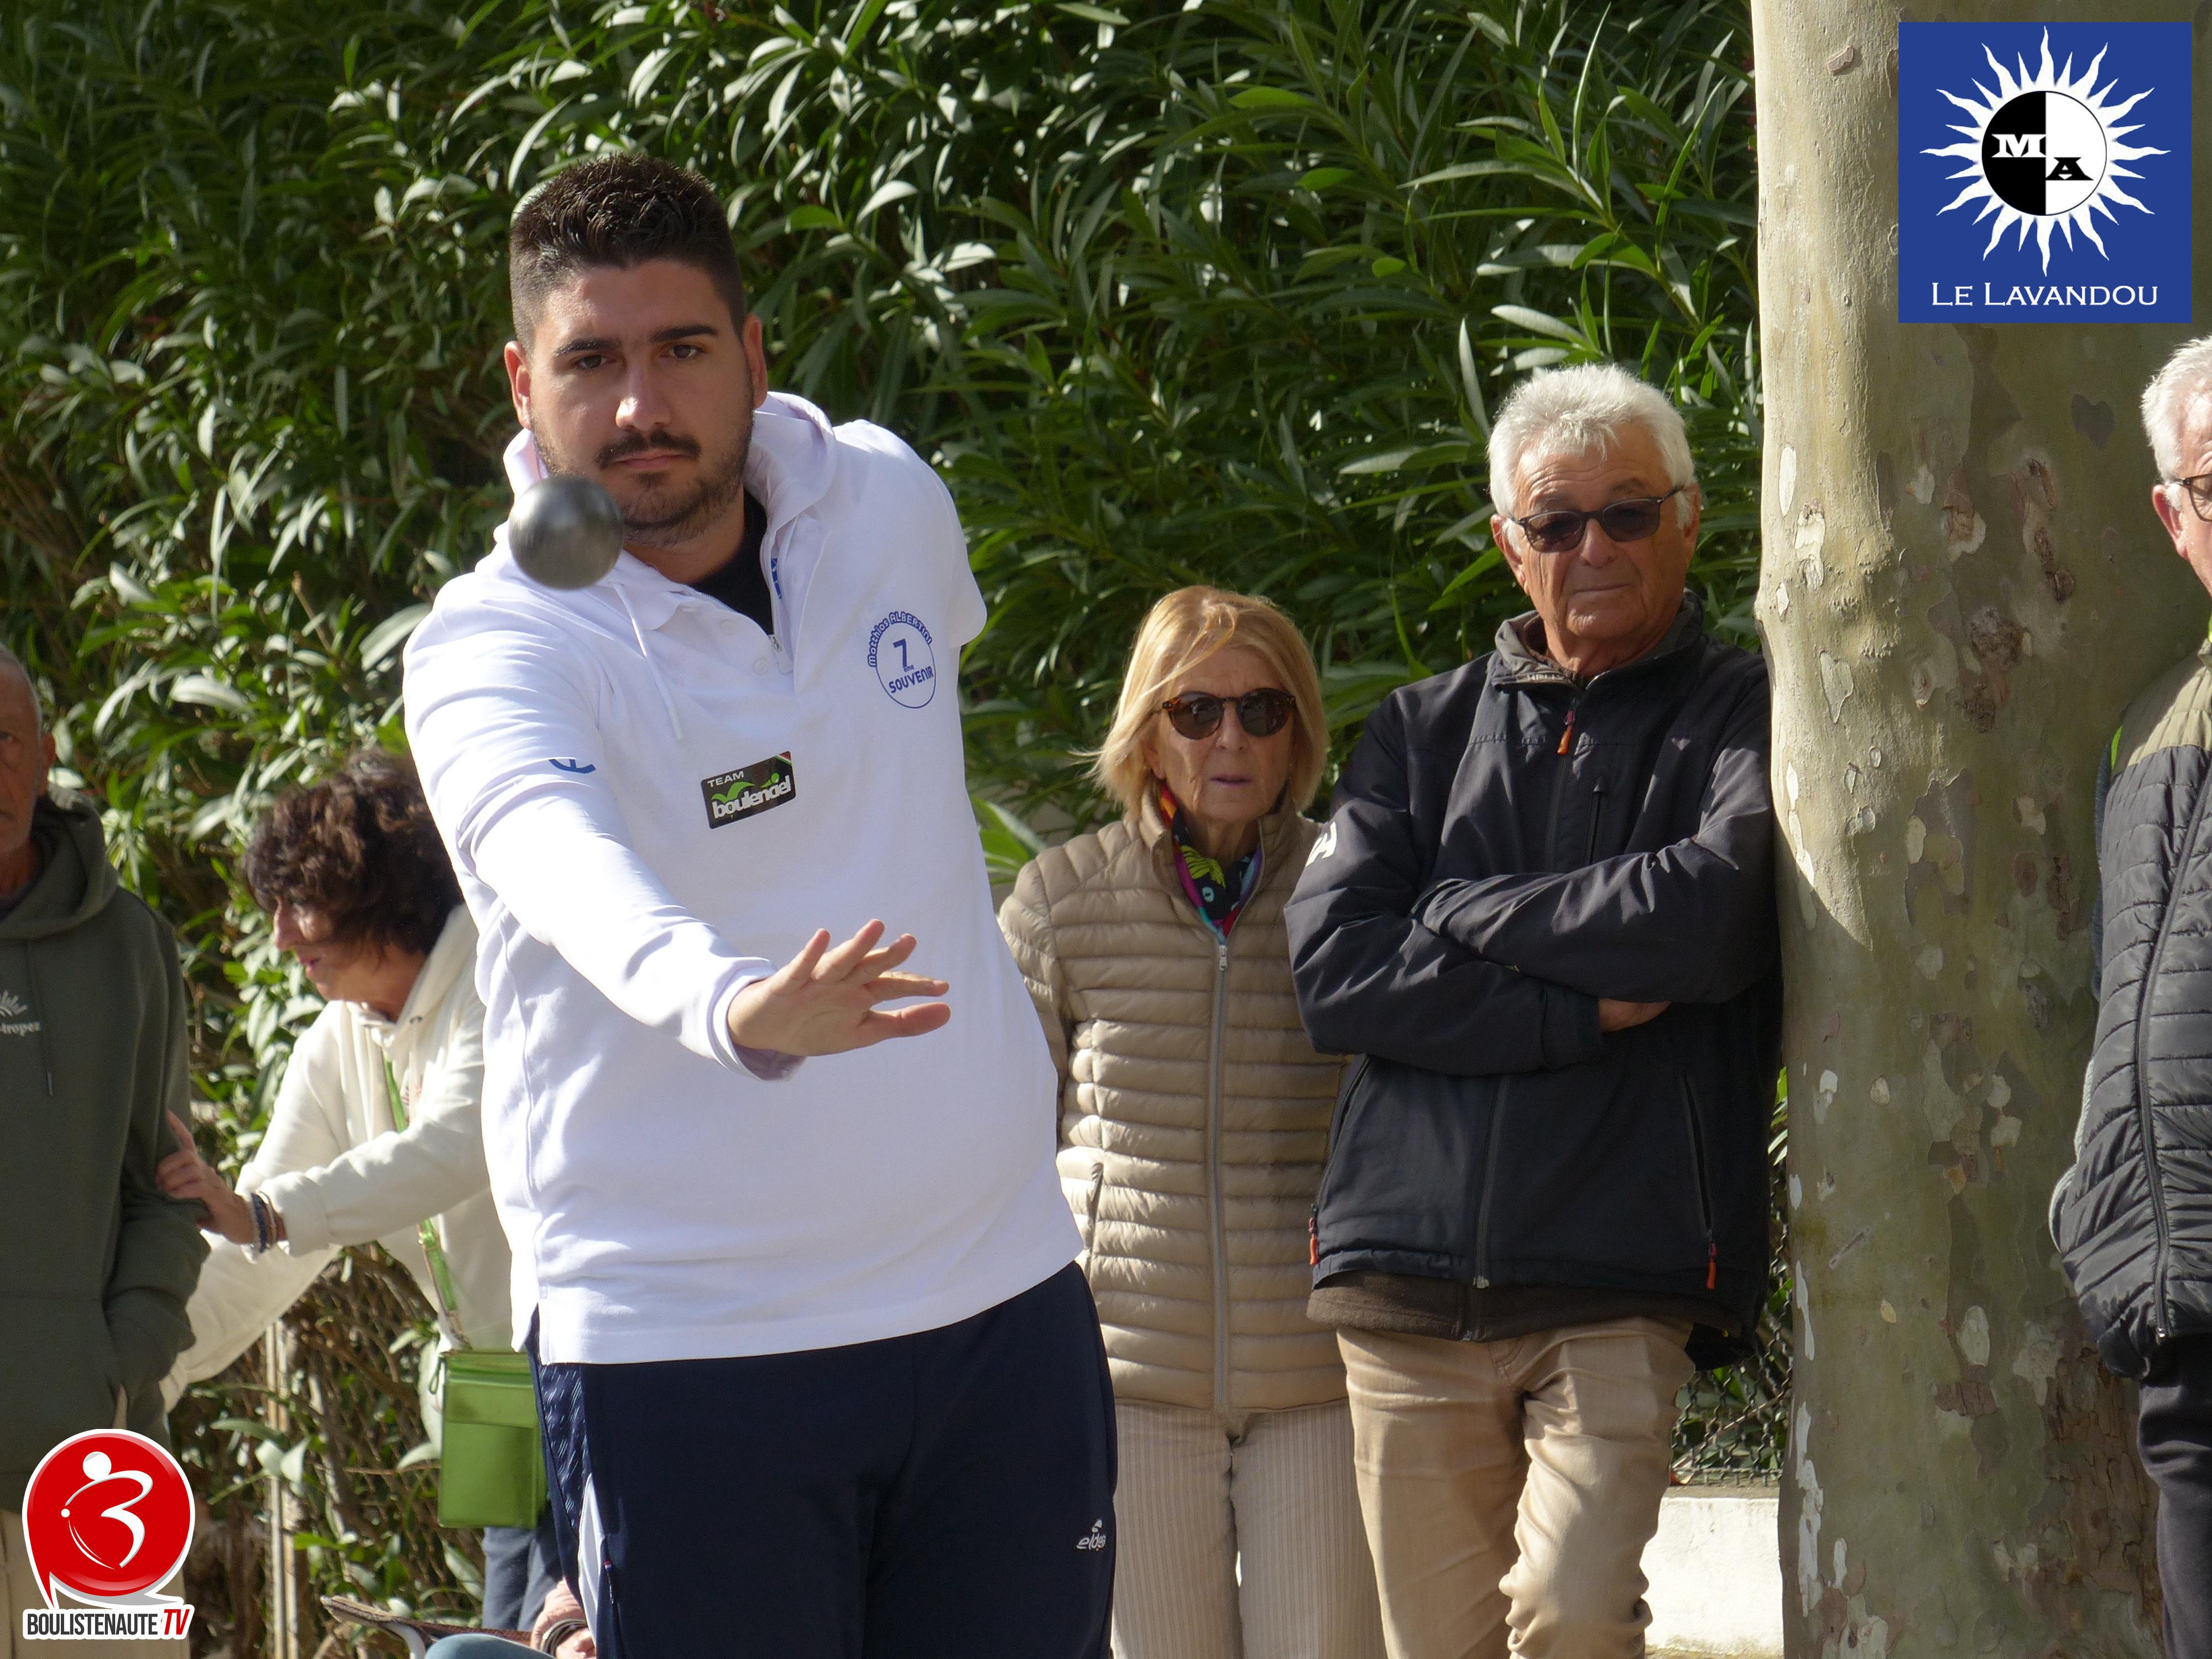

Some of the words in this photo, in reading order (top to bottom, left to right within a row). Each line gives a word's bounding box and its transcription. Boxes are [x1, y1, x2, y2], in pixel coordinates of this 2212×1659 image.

[893, 638, 907, 668] 7
[889, 666, 934, 693] SOUVENIR
[707, 771, 744, 787] TEAM
